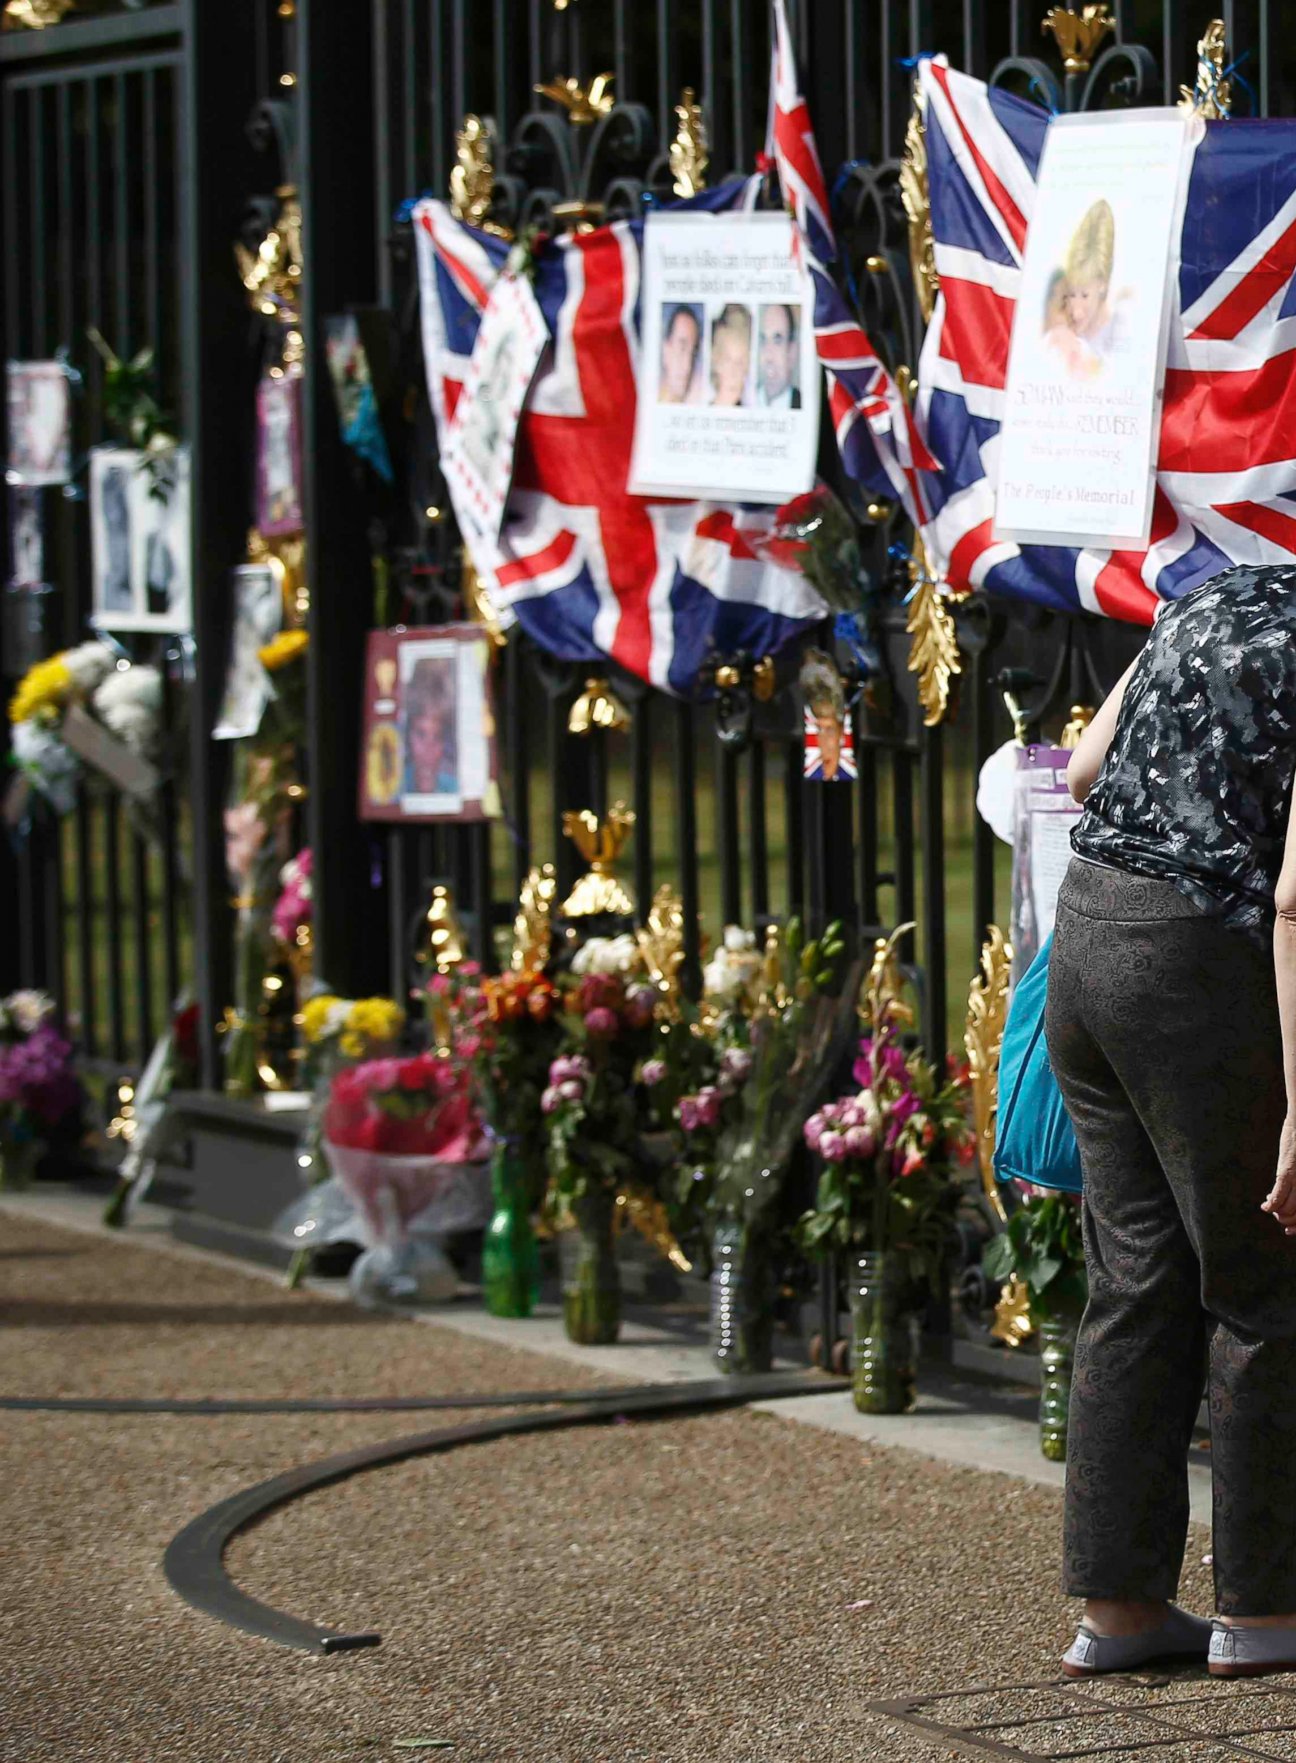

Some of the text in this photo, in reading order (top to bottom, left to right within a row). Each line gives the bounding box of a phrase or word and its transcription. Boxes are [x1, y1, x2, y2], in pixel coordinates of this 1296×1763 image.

[1003, 481, 1136, 506] The People's Memorial
